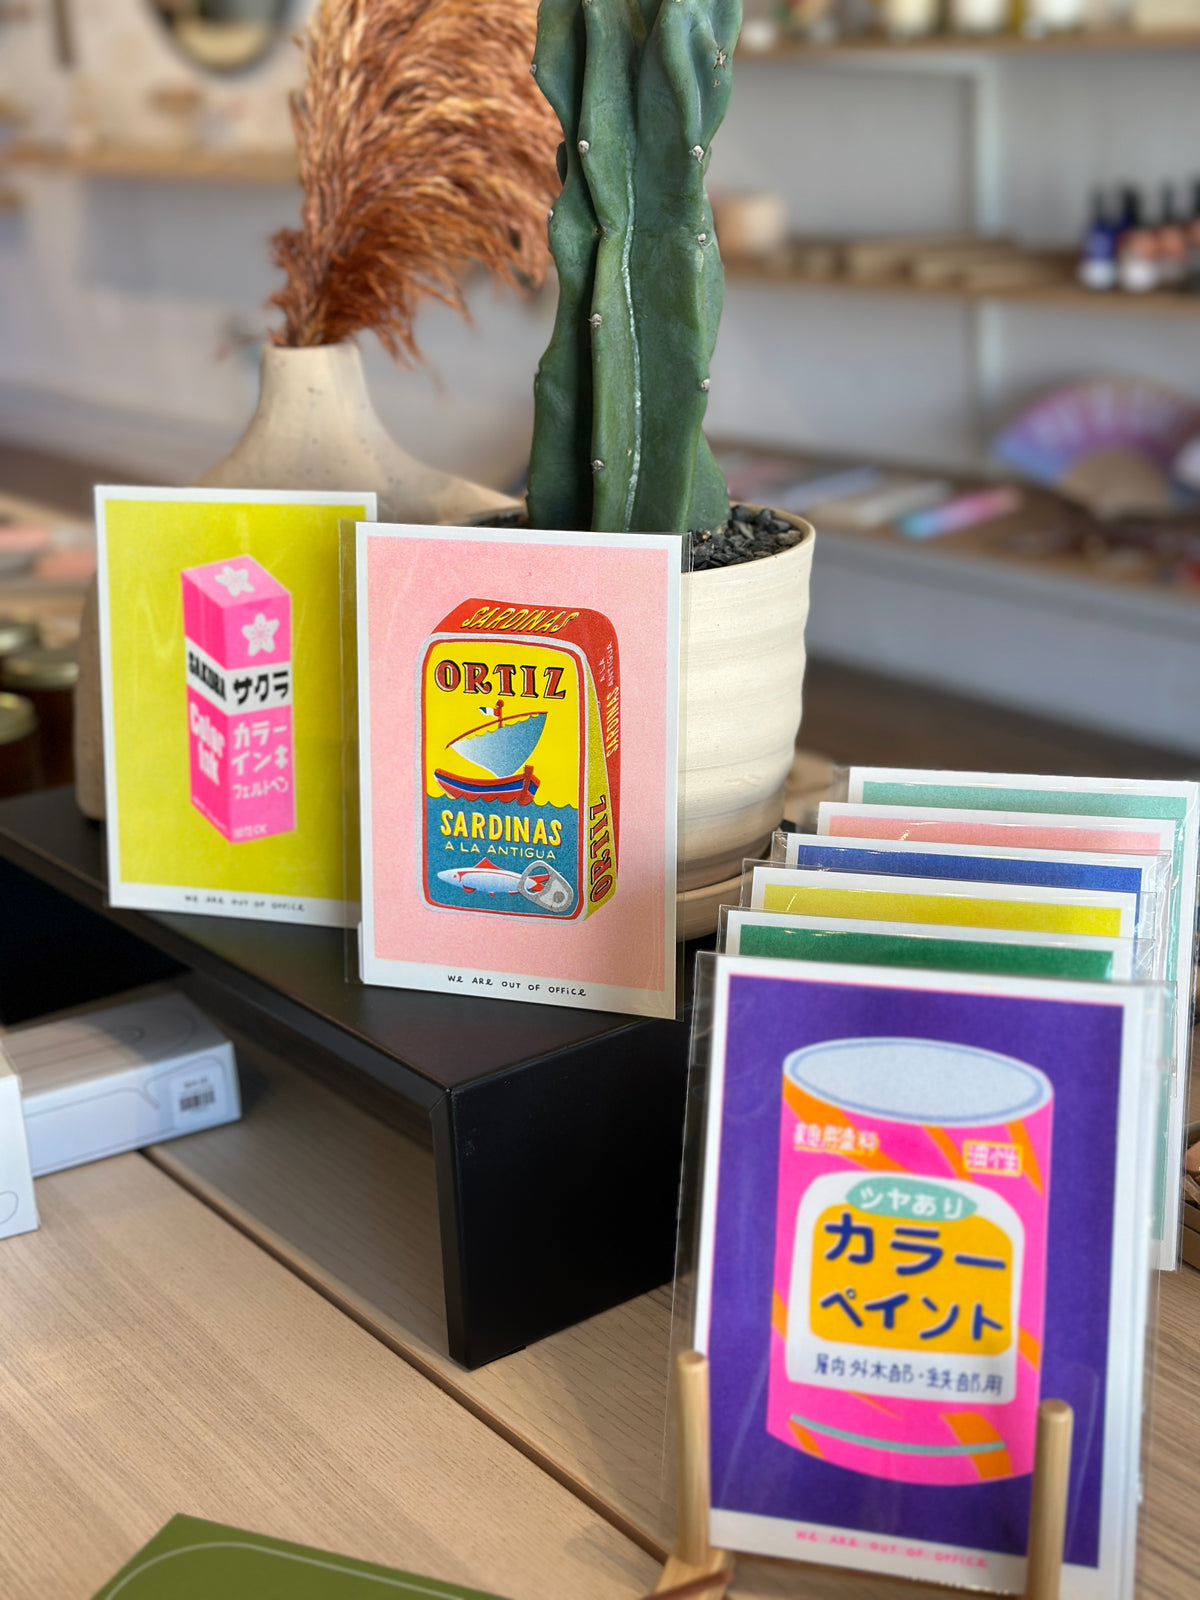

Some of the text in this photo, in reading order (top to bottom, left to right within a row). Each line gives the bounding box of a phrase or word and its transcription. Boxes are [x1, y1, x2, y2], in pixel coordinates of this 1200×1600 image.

[461, 606, 580, 634] SARDINAS
[233, 670, 288, 706] サクラ
[434, 659, 567, 700] ORTIZ
[233, 720, 288, 750] カラー
[606, 686, 619, 758] SARDINAS
[231, 745, 288, 777] インキ
[440, 809, 562, 847] SARDINAS
[444, 840, 556, 860] A LA ANTIGUA
[589, 794, 614, 903] ORTIZ
[501, 980, 521, 989] OUT
[527, 983, 541, 992] OF
[860, 1185, 963, 1220] ツヤあり
[823, 1211, 1006, 1276] カラー
[820, 1288, 1004, 1341] ペイント
